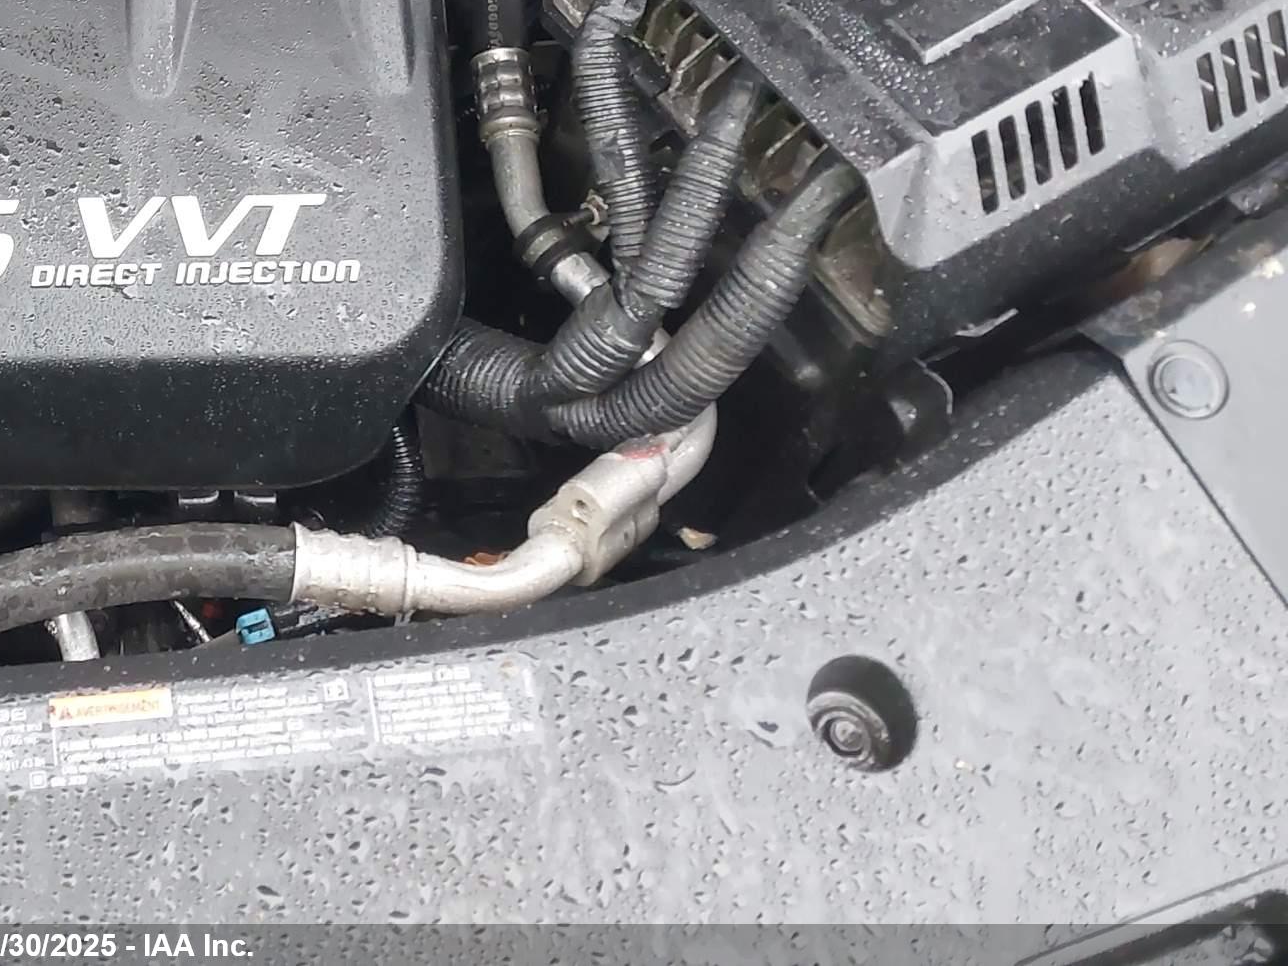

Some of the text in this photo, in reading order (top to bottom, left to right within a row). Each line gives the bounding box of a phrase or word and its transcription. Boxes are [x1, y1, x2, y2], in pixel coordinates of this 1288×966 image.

[77, 193, 327, 258] VVT
[32, 260, 361, 286] DIRECT INJECTION
